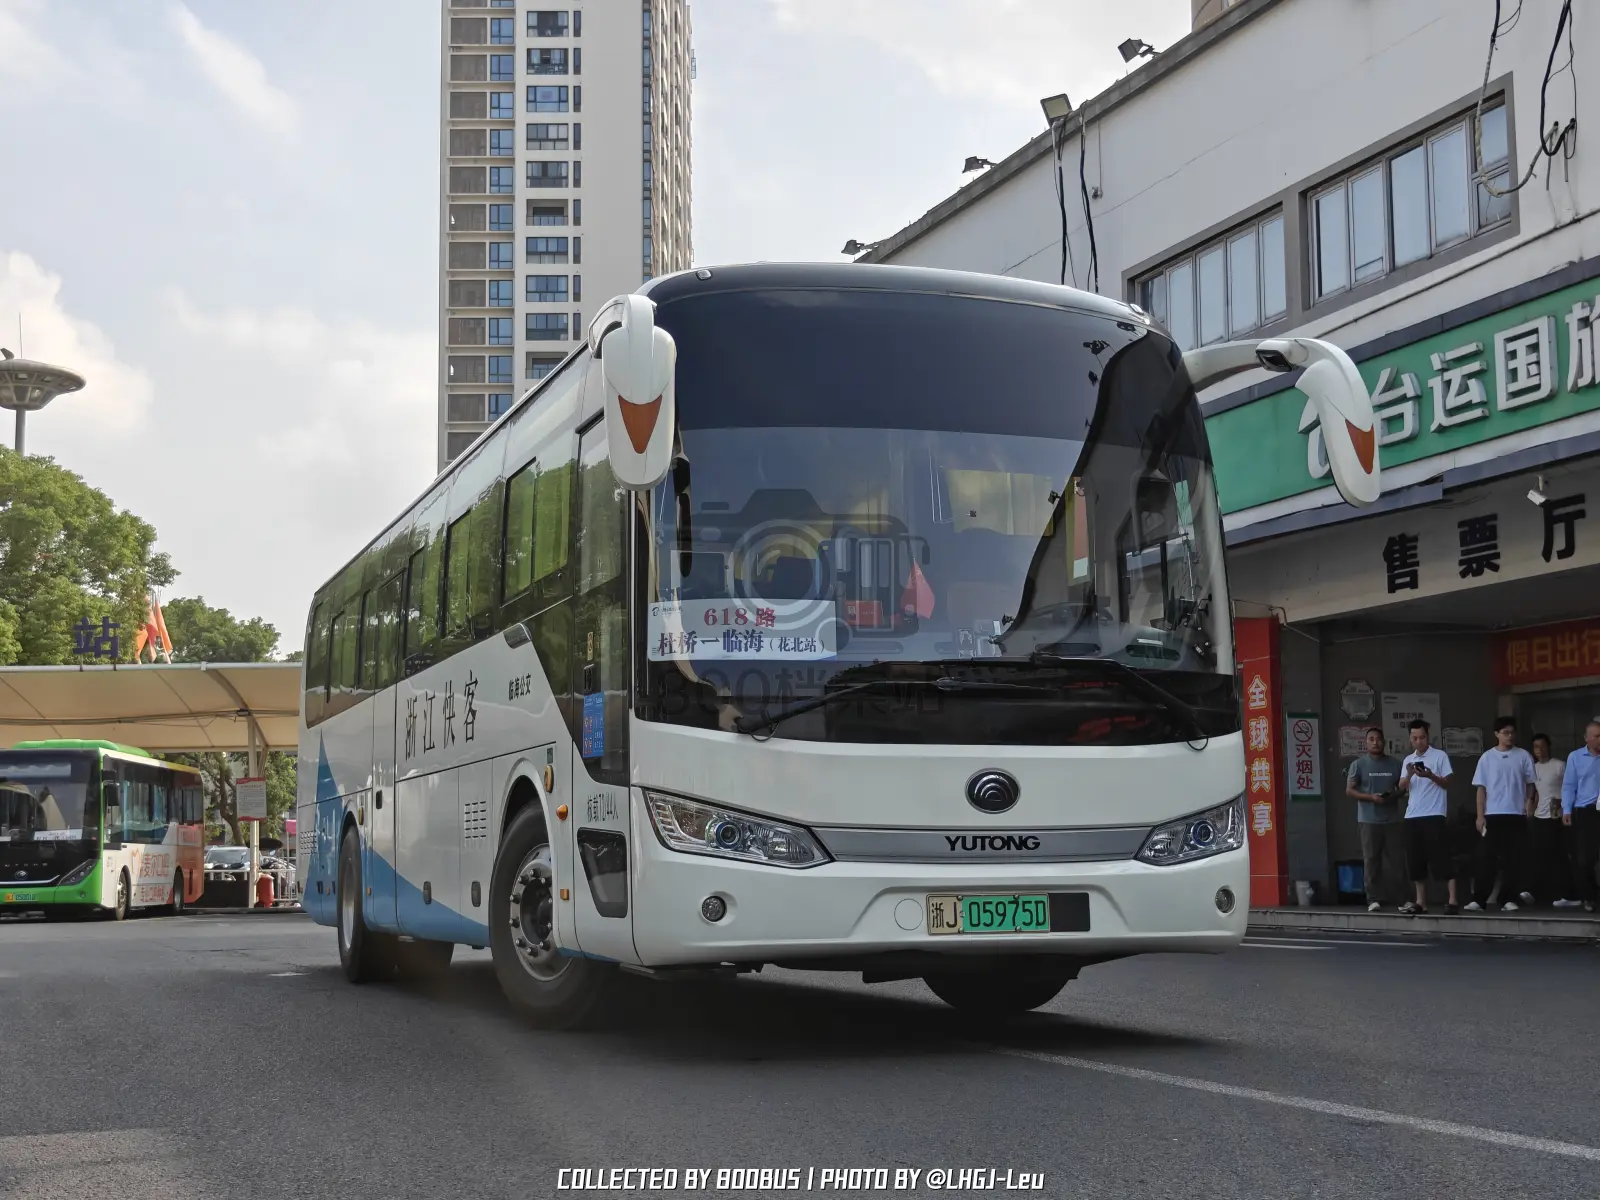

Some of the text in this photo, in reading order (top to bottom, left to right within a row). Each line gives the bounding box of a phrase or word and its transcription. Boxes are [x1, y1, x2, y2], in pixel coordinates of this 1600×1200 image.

[1382, 493, 1587, 594] 售票厅
[73, 616, 120, 658] 站
[704, 607, 748, 626] 618
[755, 607, 776, 627] 路
[658, 631, 698, 656] 杜桥
[722, 629, 764, 653] 临海
[1506, 628, 1600, 677] 假日出行
[508, 673, 532, 702] 临海公交
[405, 669, 479, 761] 浙江快客
[1247, 675, 1273, 837] 全球共享
[1295, 744, 1315, 790] 灭烟处
[945, 836, 1041, 851] YUTONG
[931, 900, 1047, 929] 浙J 05975D
